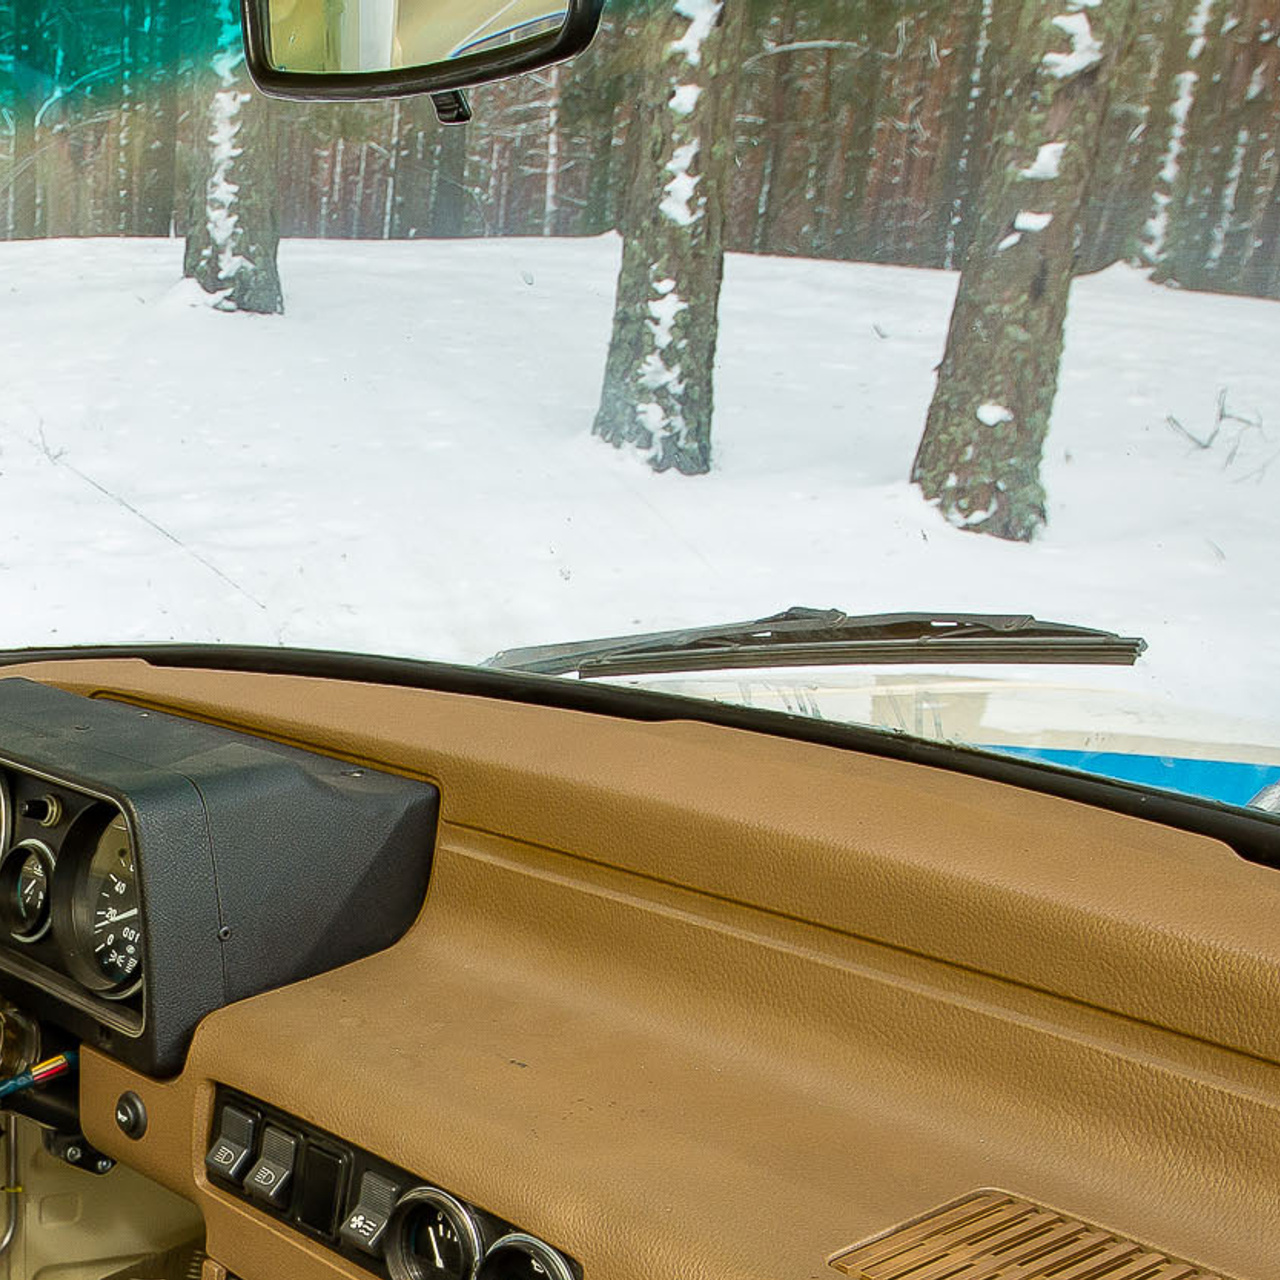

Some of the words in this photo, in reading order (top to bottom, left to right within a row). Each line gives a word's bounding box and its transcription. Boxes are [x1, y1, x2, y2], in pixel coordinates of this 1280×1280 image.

[114, 881, 127, 895] 40
[105, 907, 118, 921] 20
[106, 933, 115, 946] 0
